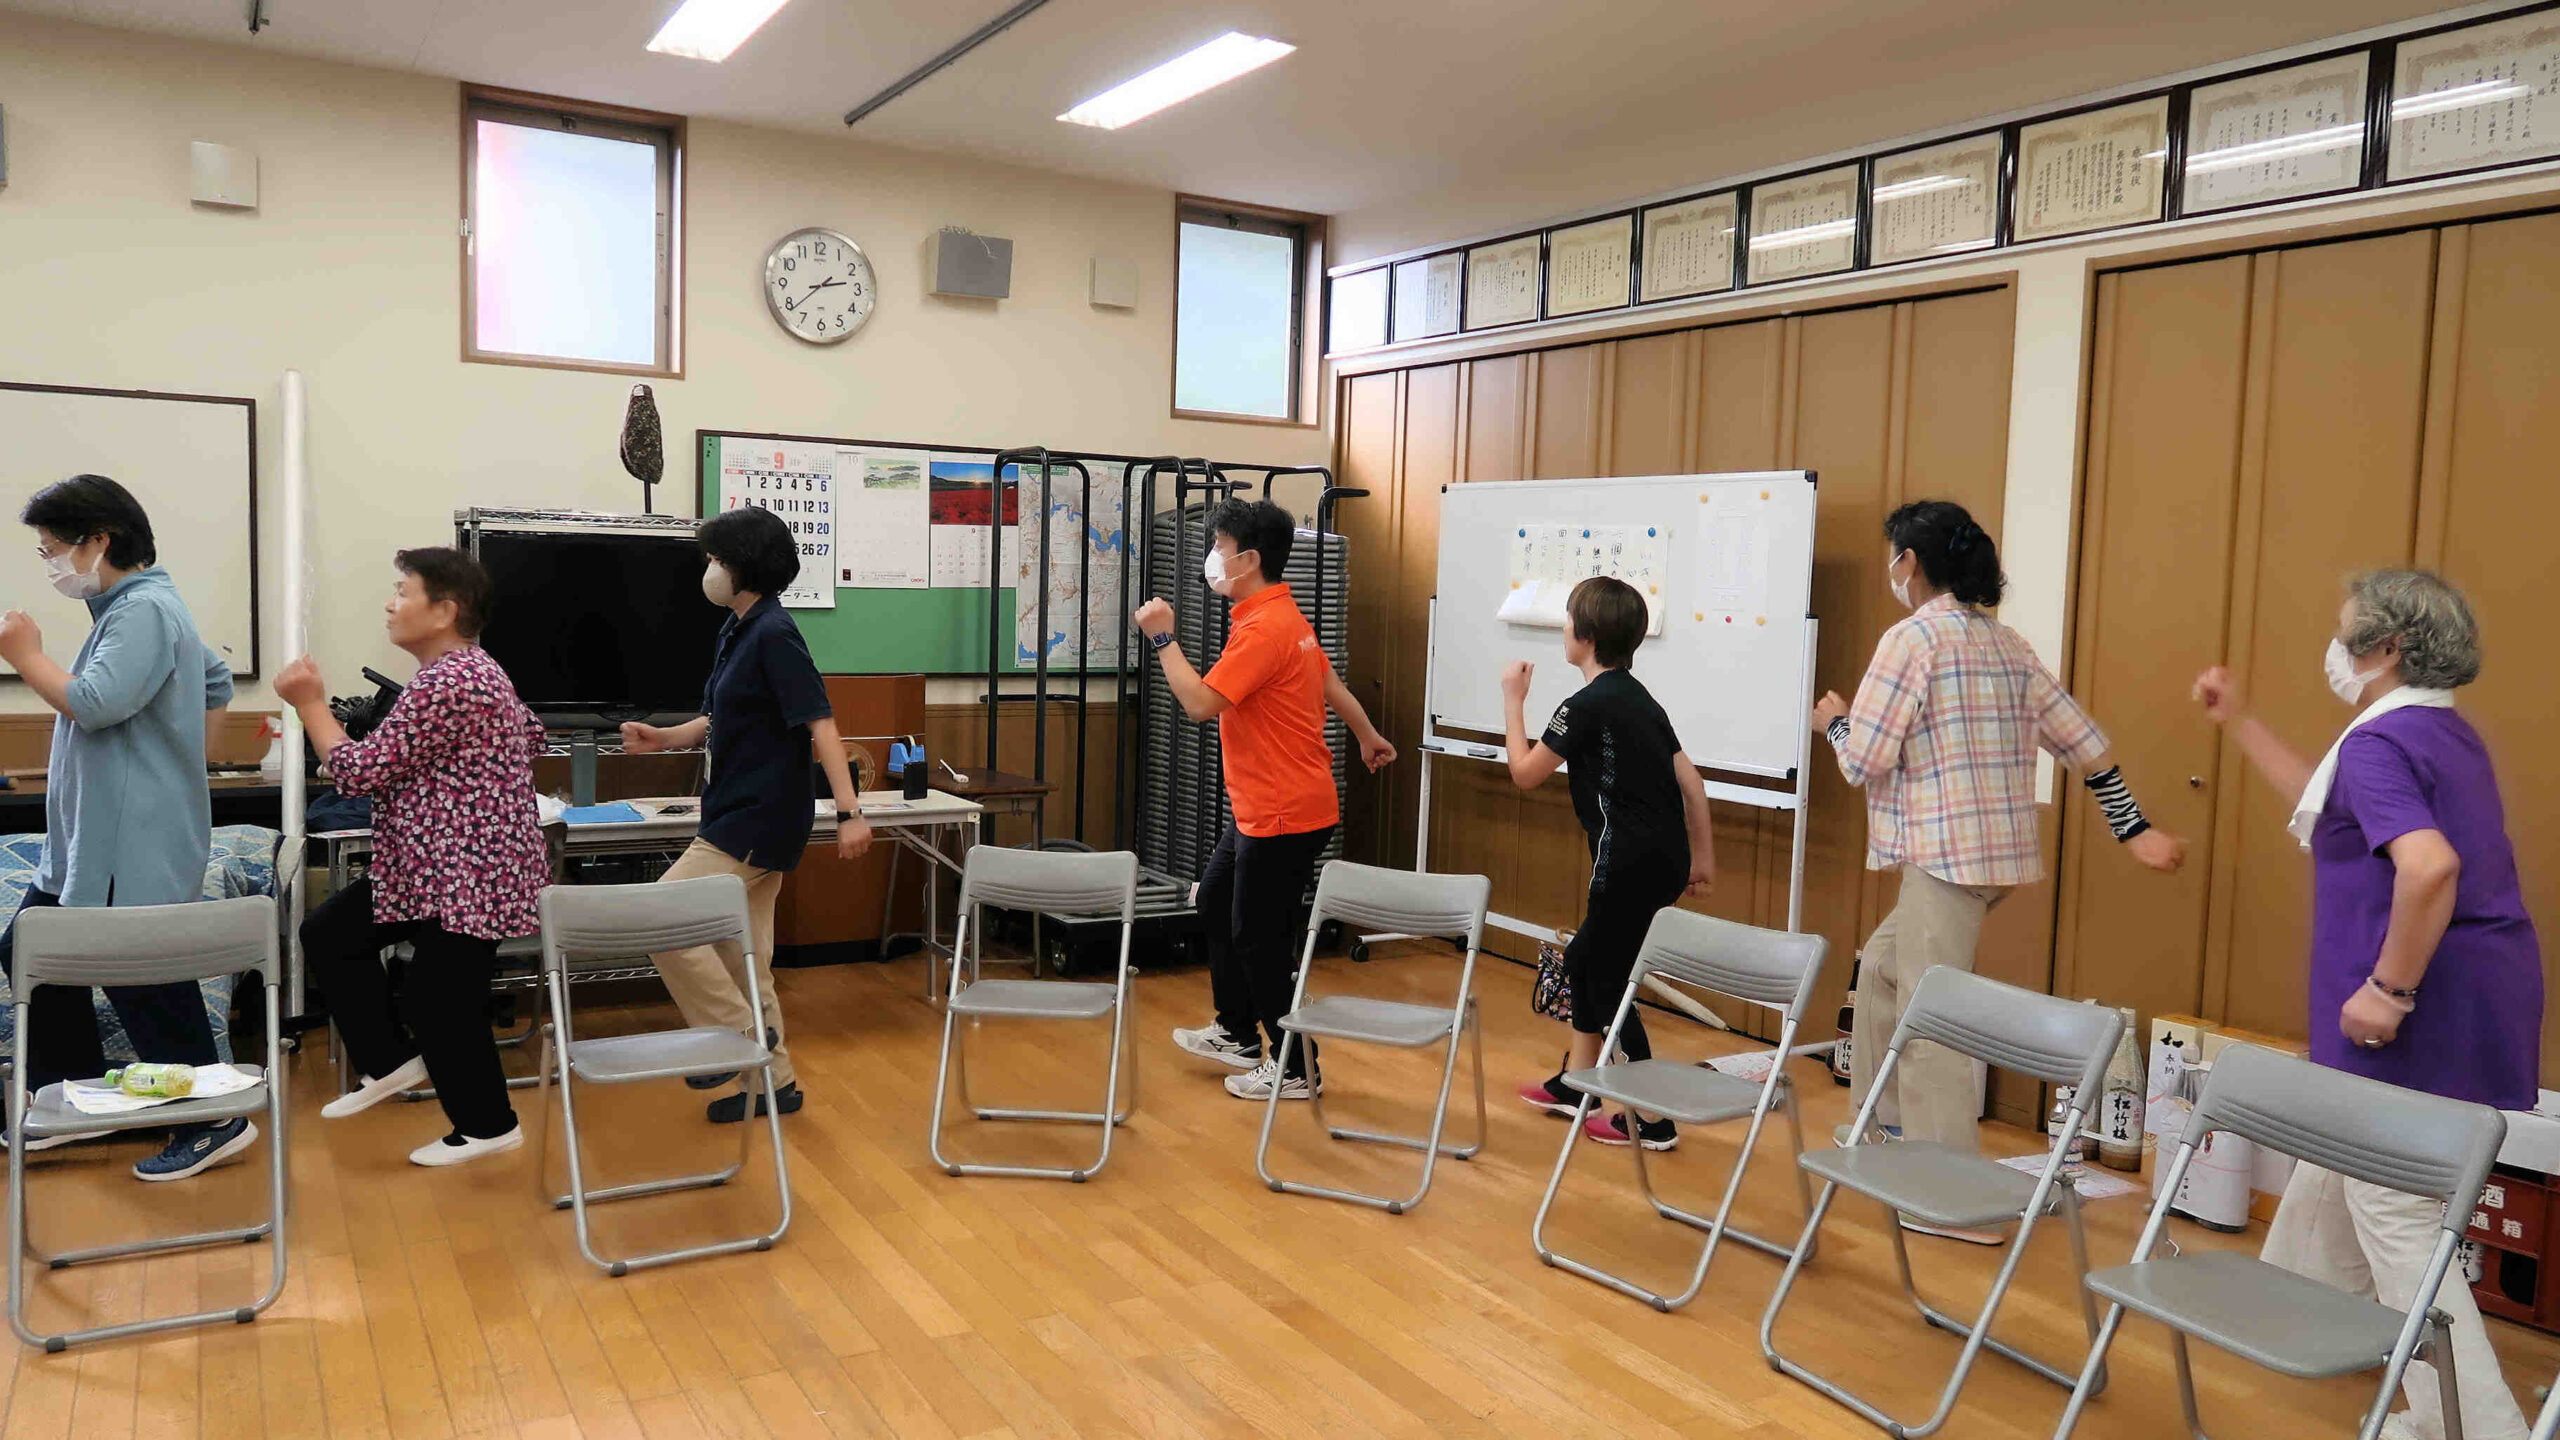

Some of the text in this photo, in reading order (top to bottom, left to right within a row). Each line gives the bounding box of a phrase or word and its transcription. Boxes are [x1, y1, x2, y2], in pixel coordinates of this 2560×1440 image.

[797, 245, 808, 259] 11
[814, 241, 827, 256] 12
[783, 257, 796, 271] 10
[847, 263, 857, 276] 2
[778, 277, 788, 290] 9
[853, 283, 862, 296] 3
[785, 297, 794, 311] 8
[848, 302, 857, 314] 4
[800, 312, 808, 324] 7
[835, 315, 844, 328] 5
[817, 319, 826, 332] 6
[773, 452, 785, 470] 9
[848, 455, 859, 466] 10
[747, 476, 828, 493] 1 2 3 4 5 6
[730, 497, 737, 509] 7
[760, 499, 768, 511] 9
[773, 500, 784, 511] 10
[789, 501, 799, 513] 11
[804, 501, 814, 513] 12
[818, 502, 829, 514] 13
[803, 522, 814, 534] 19
[817, 523, 830, 535] 20
[802, 544, 815, 556] 26
[817, 545, 830, 556] 27
[777, 591, 820, 601] ータース
[2112, 1095, 2131, 1141] 松竹梅
